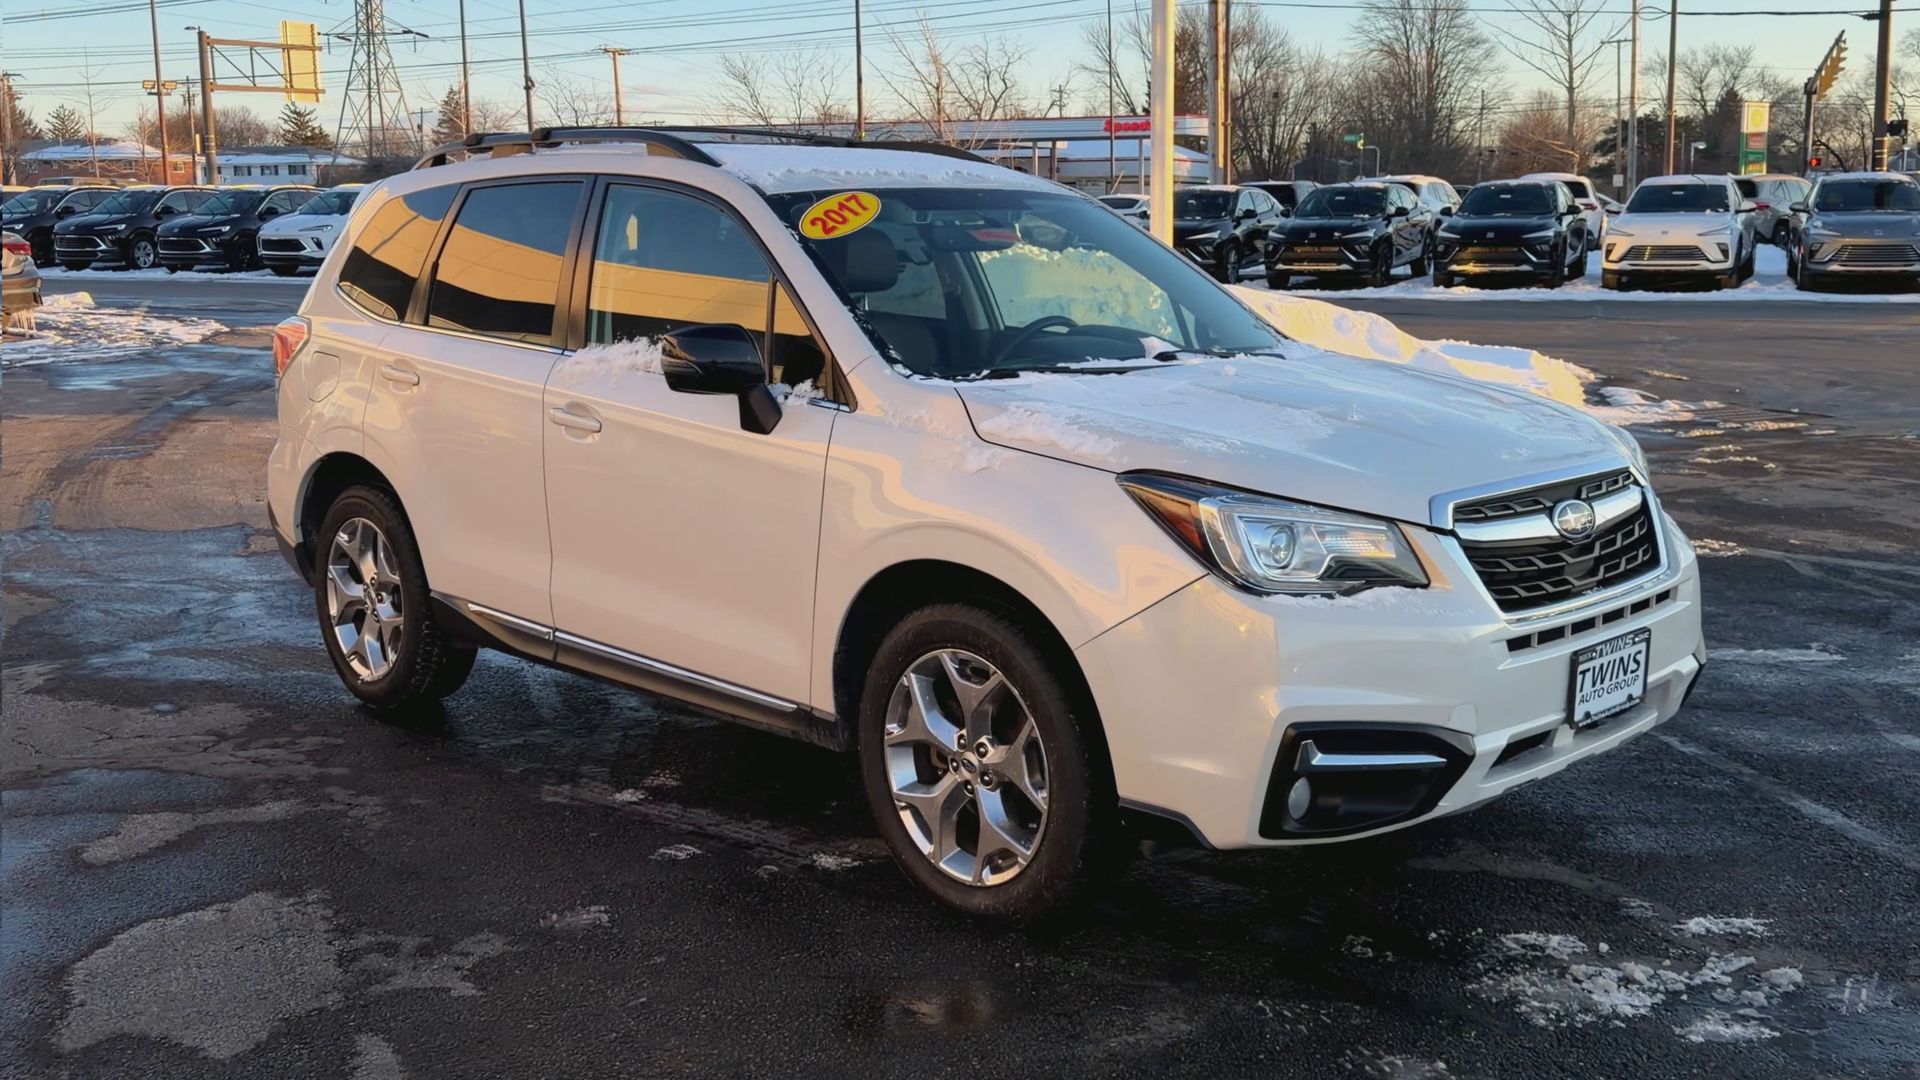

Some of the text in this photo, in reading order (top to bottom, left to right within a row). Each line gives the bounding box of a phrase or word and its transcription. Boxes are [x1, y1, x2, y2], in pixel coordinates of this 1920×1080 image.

[1104, 119, 1177, 133] Speed
[809, 194, 869, 235] 2017
[1596, 635, 1635, 659] TWINS
[1578, 650, 1643, 693] TWINS
[1578, 674, 1640, 706] AUTO GROUP
